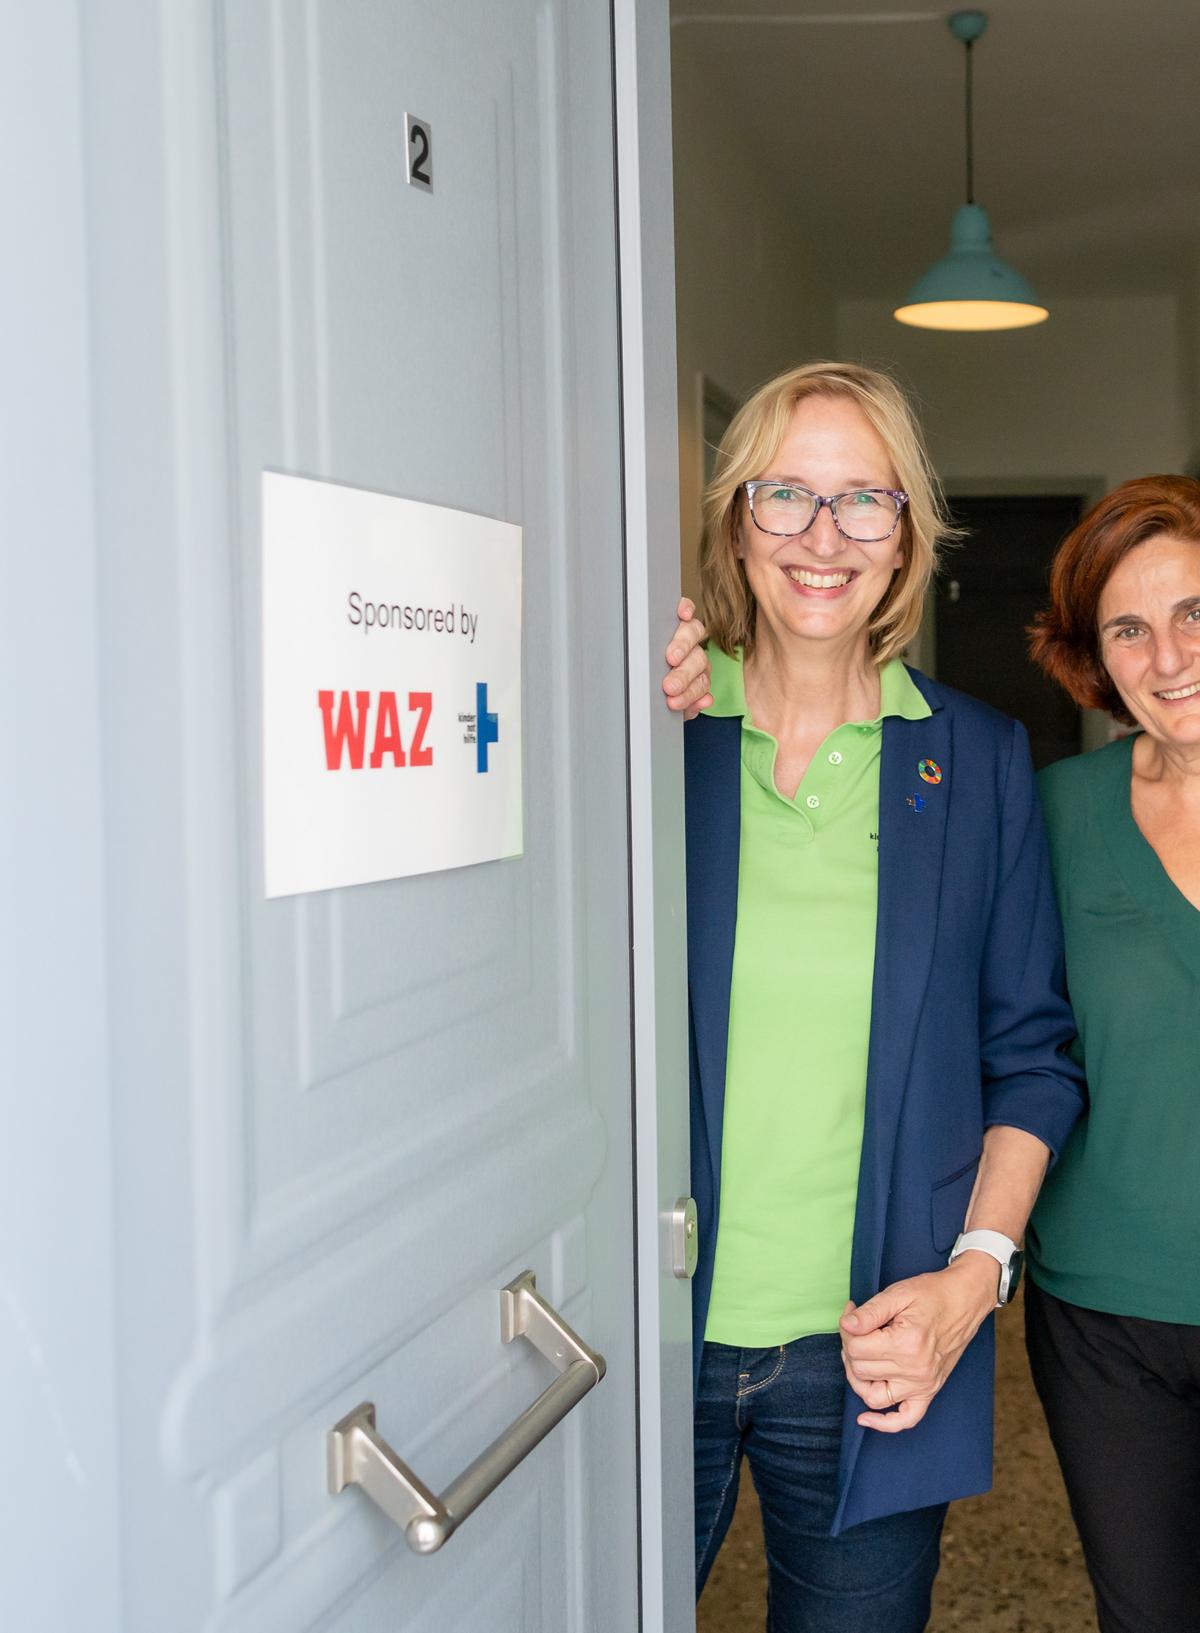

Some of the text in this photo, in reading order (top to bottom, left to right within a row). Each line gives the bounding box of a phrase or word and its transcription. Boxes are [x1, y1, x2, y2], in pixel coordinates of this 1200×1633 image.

[410, 124, 430, 185] 2
[348, 590, 478, 643] Sponsored by
[318, 690, 433, 771] WAZ
